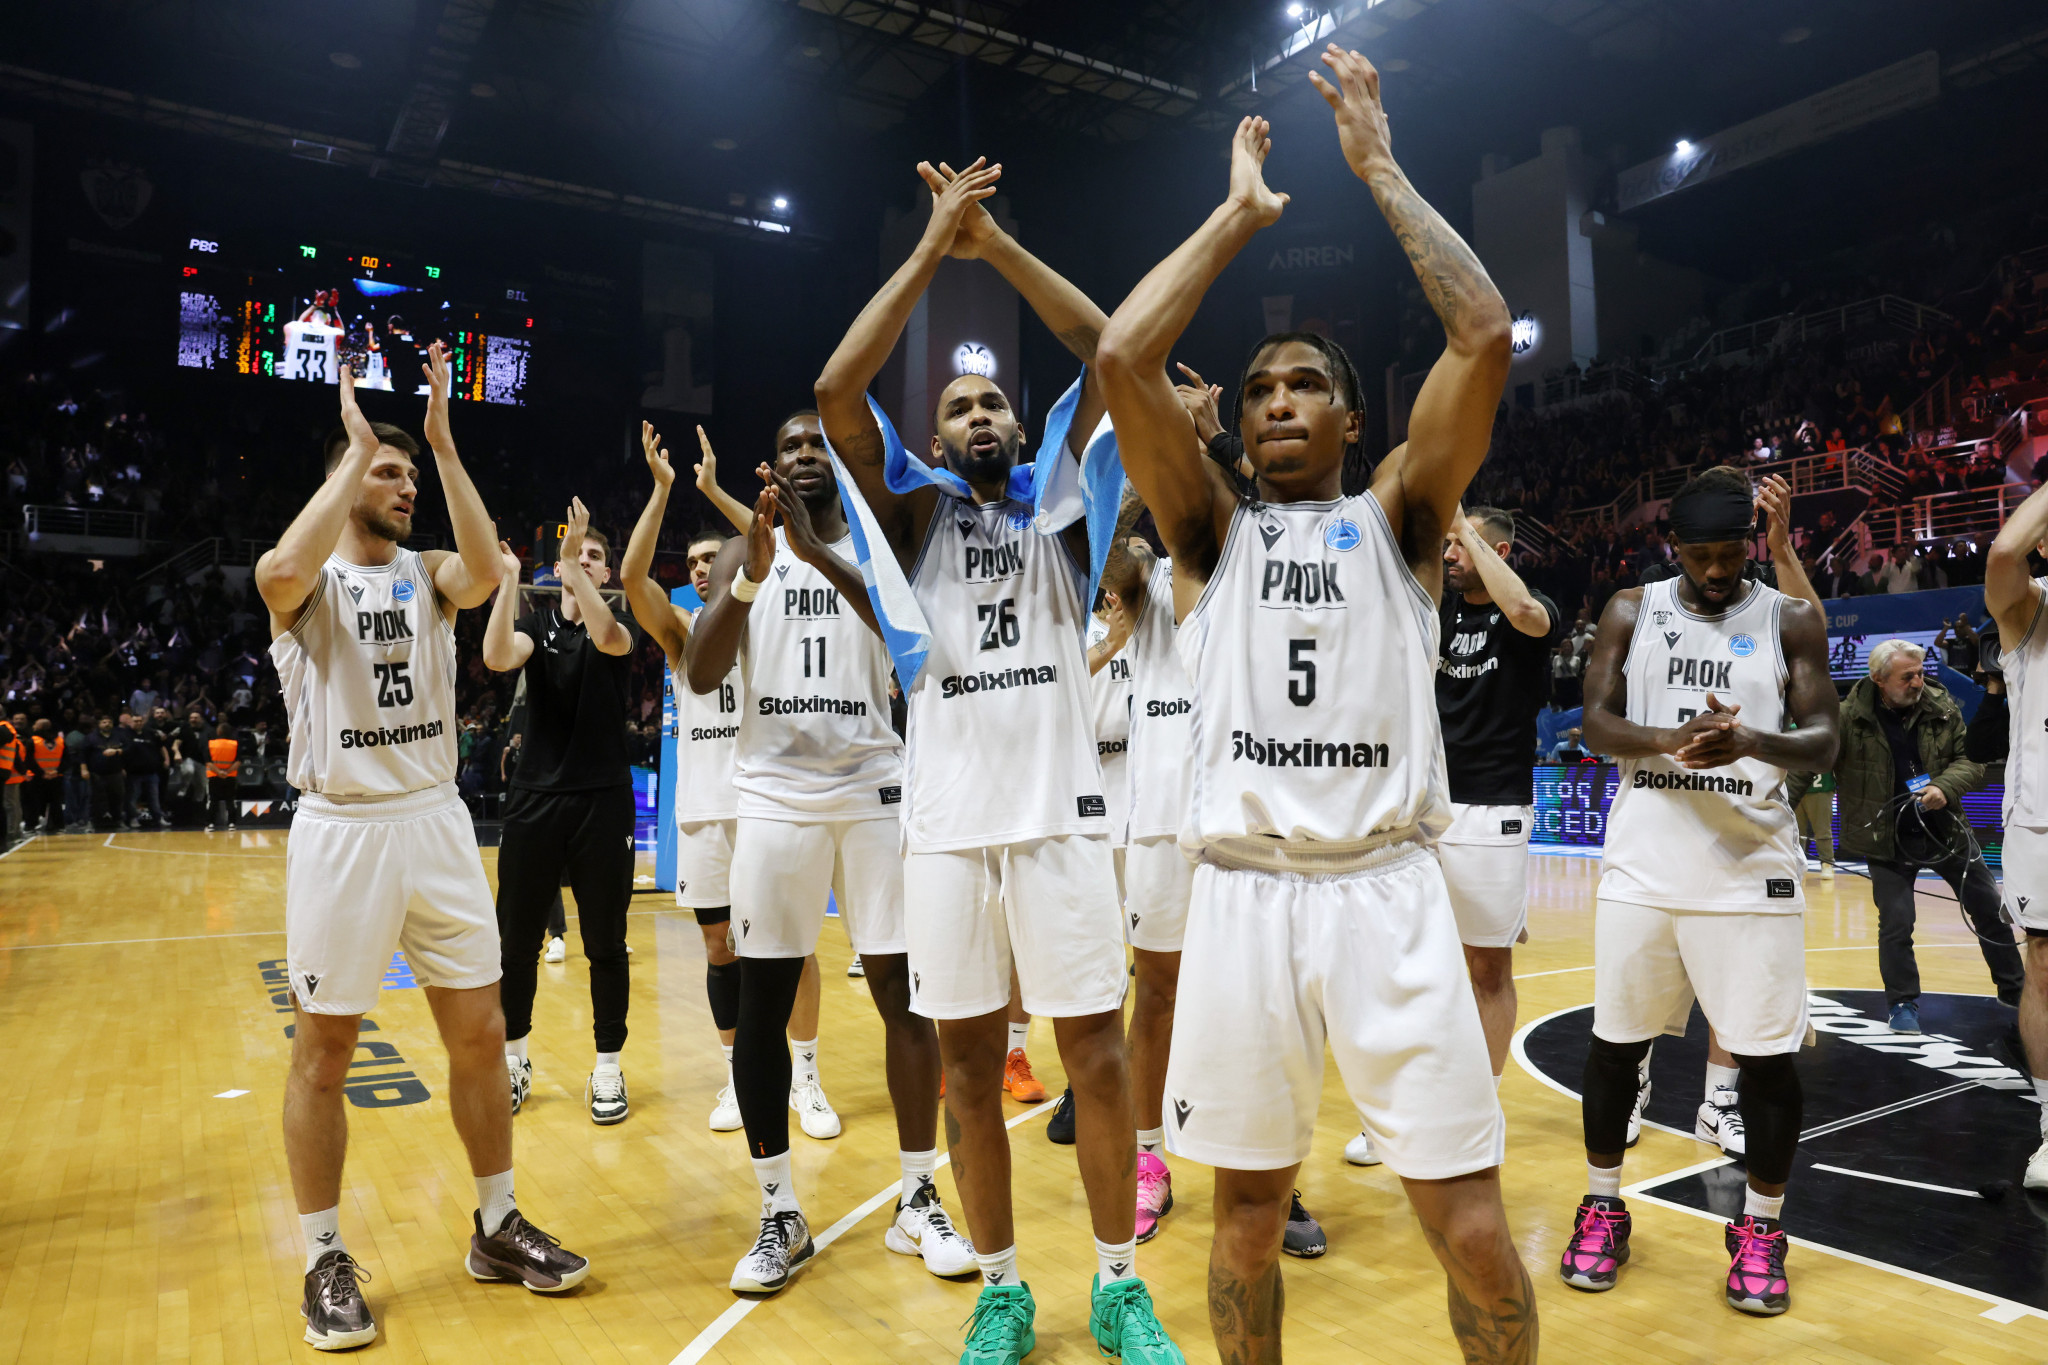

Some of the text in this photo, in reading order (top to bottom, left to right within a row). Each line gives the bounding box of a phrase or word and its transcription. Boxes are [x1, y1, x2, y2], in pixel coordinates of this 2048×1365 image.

[189, 238, 219, 253] PBC
[300, 245, 316, 258] 79
[366, 269, 374, 279] 4
[425, 266, 440, 279] 73
[506, 290, 528, 302] BIL
[526, 318, 534, 328] 3
[296, 349, 327, 382] 33
[965, 540, 1024, 579] PAOK
[1261, 559, 1345, 605] PAOK
[784, 588, 840, 616] PAOK
[357, 608, 414, 642] PAOK
[977, 597, 1020, 651] 26
[1836, 613, 1859, 629] CUP
[800, 636, 827, 678] 11
[1449, 630, 1488, 655] PAOK
[941, 664, 1058, 699] Stoixima
[1110, 658, 1132, 680] PA
[1288, 638, 1316, 707] 5
[1667, 656, 1733, 690] PAOK
[373, 661, 414, 708] 25
[718, 683, 736, 714] 18
[758, 694, 867, 717] Stoiximan
[340, 718, 444, 750] Stoiximan
[1097, 738, 1129, 756] Stoi
[1231, 730, 1389, 768] Stoiximan
[1633, 769, 1754, 797] Stoiximan
